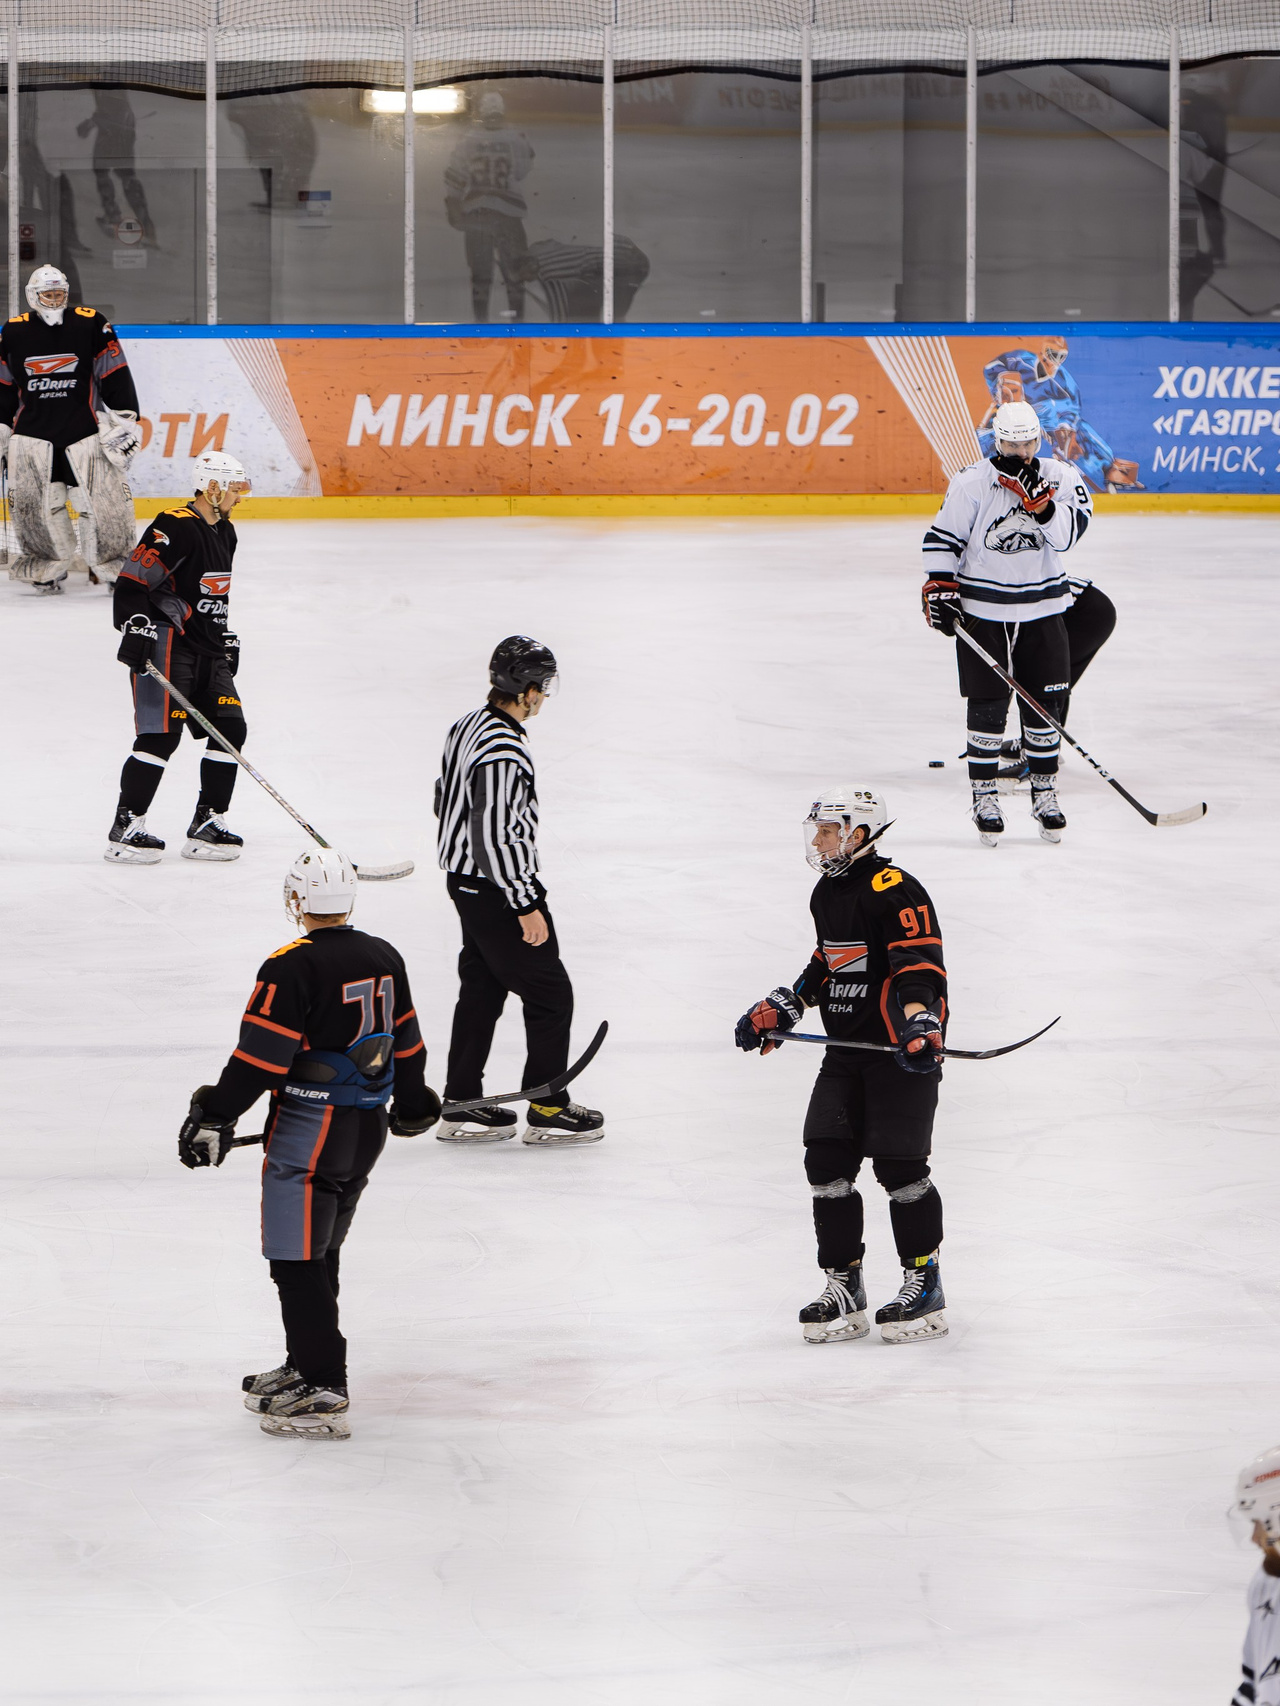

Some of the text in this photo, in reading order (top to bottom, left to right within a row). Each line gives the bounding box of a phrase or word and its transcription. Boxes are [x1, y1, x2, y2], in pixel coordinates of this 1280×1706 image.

[346, 393, 860, 447] МИНСК 16-20.02
[1151, 445, 1266, 476] МИНСК,
[1043, 682, 1070, 692] CCM
[898, 904, 932, 938] 97
[246, 980, 278, 1016] 71
[342, 974, 395, 1047] 71
